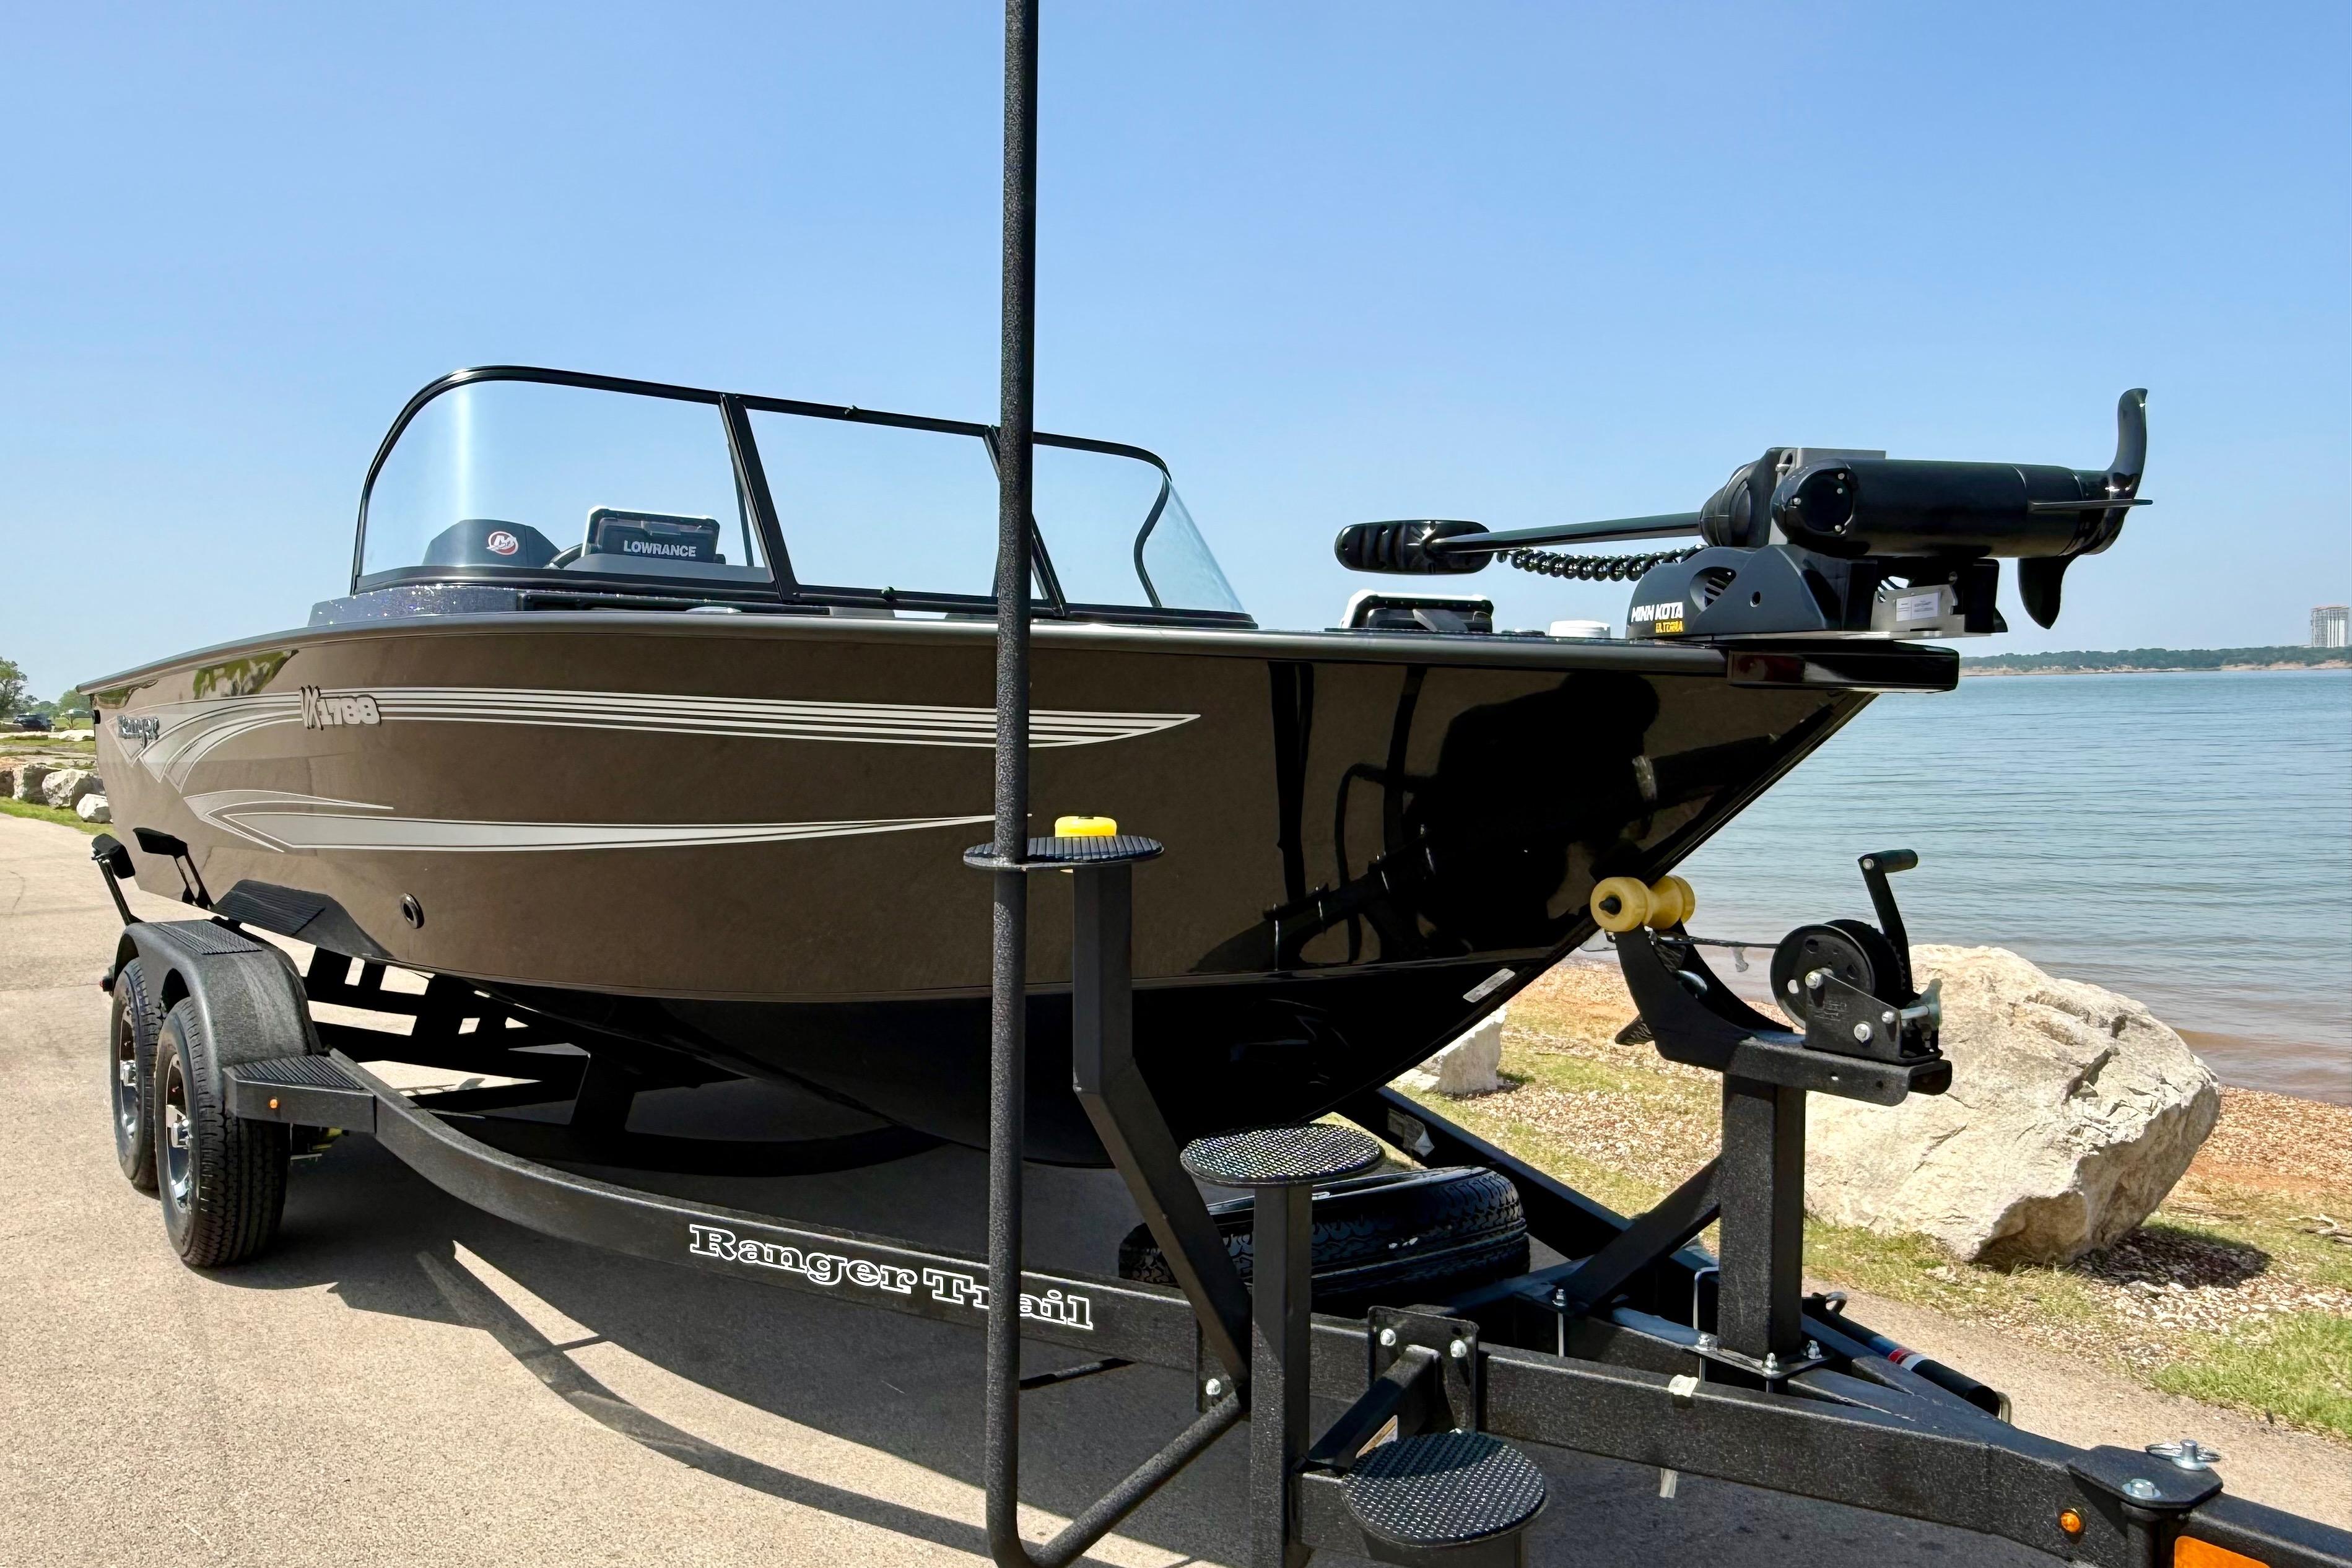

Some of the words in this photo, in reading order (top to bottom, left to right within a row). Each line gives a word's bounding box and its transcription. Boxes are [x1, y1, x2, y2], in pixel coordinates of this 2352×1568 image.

[623, 540, 697, 557] LOWRANCE
[1631, 604, 1655, 622] MINN
[1655, 602, 1683, 620] KOTA
[689, 1224, 918, 1294] Ranger
